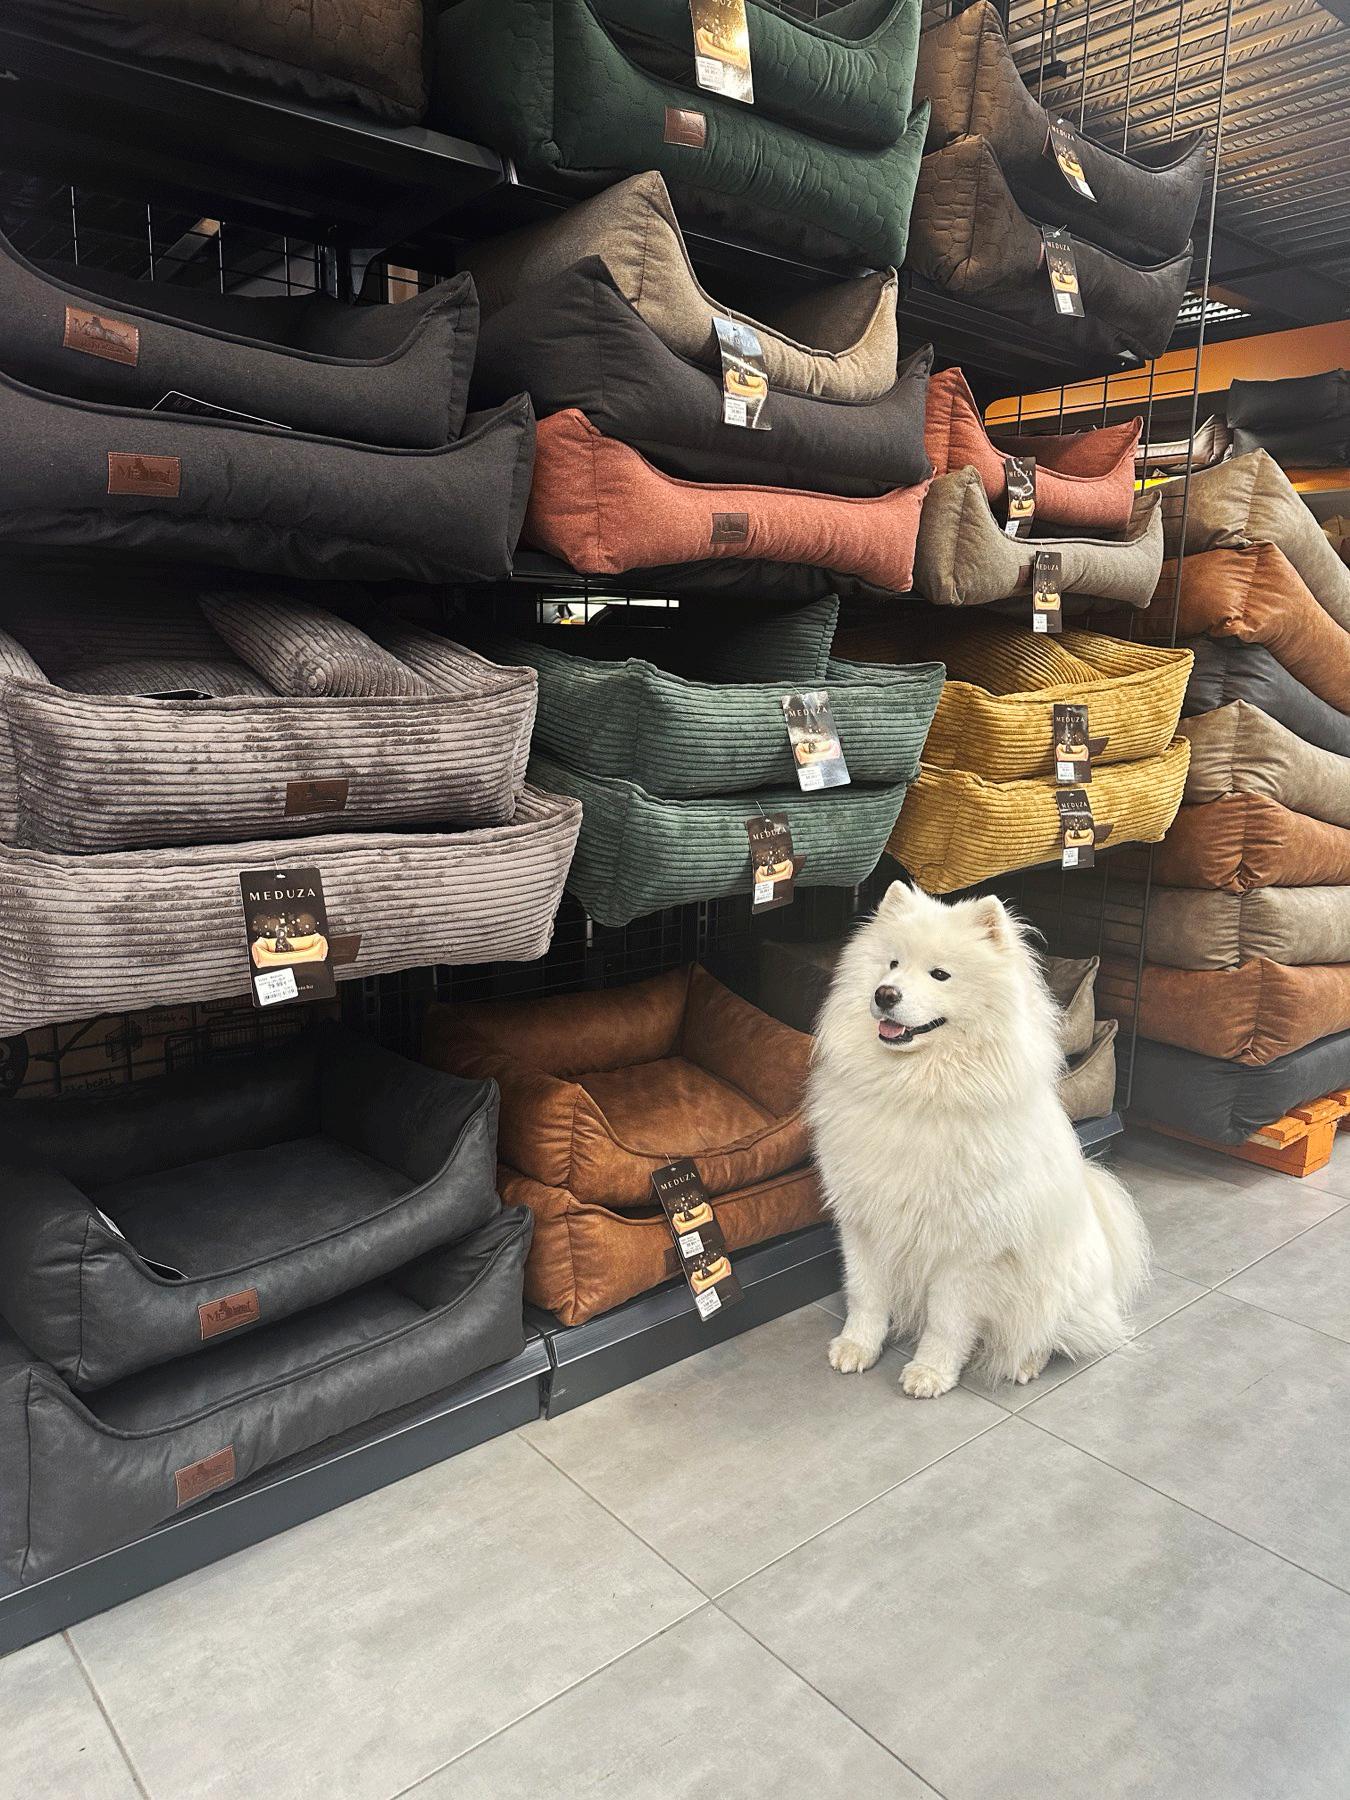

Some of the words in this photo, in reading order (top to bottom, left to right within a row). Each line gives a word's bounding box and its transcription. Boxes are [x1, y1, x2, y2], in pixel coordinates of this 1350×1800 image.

[1046, 241, 1071, 252] MEDUZA
[1061, 801, 1088, 809] MEDUZA
[752, 826, 787, 840] MEDUZA
[249, 888, 316, 901] MEDUZA
[660, 1172, 697, 1190] MEDUZA
